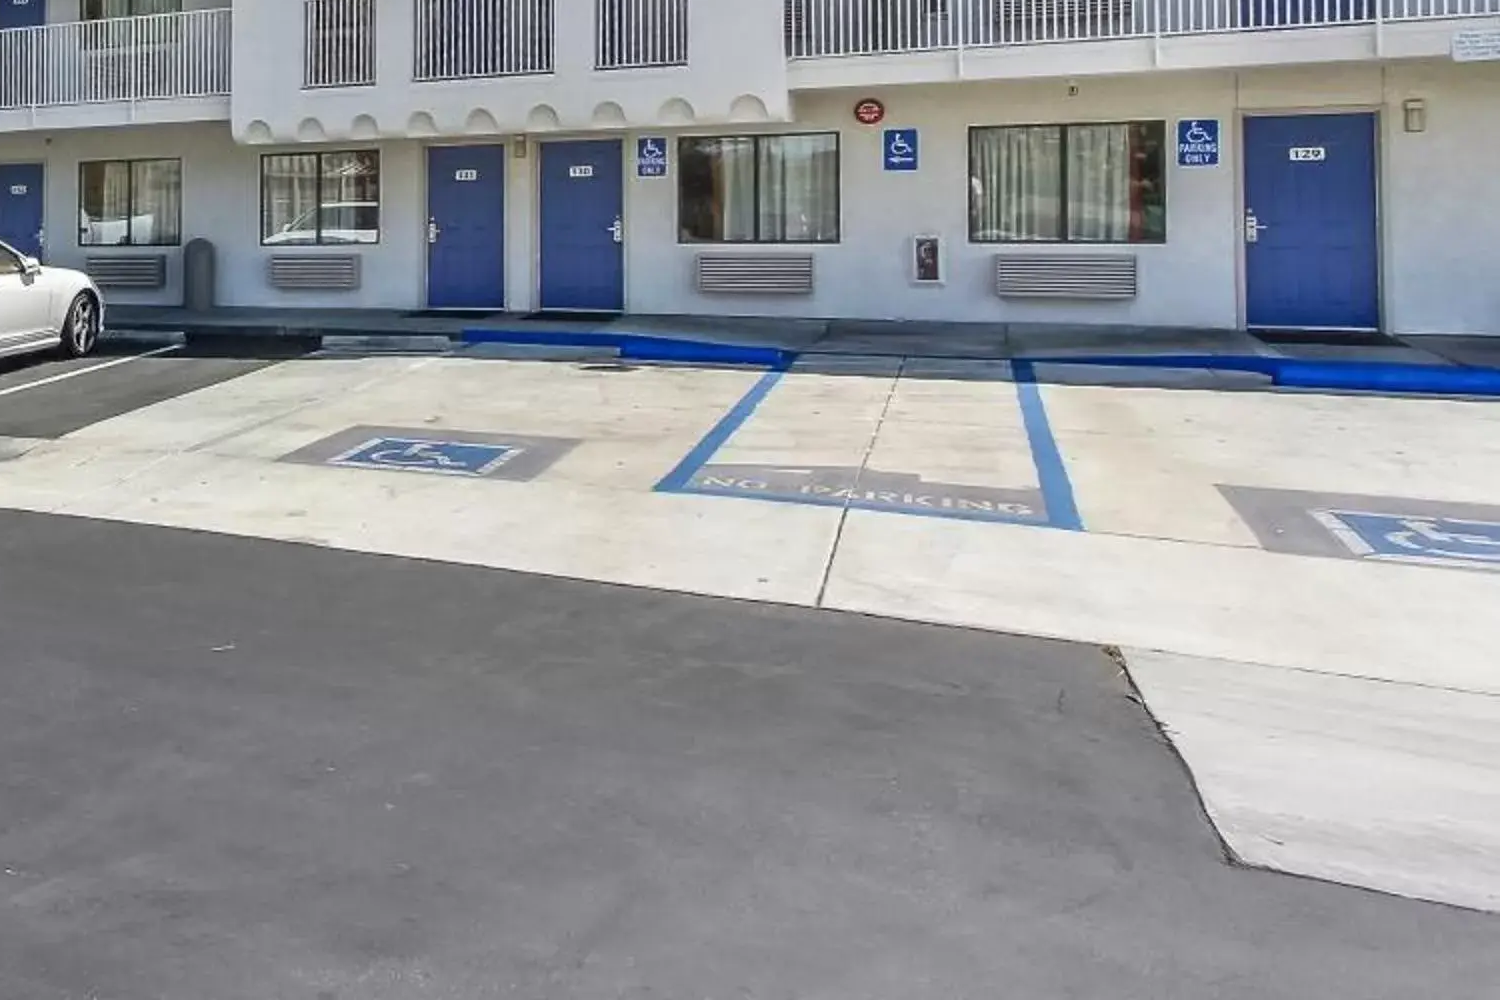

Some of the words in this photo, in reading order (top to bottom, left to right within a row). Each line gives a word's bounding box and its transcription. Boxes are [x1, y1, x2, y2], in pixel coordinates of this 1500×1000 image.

[1180, 143, 1217, 152] PARKING
[1185, 154, 1210, 162] ONLY
[1292, 149, 1321, 159] 129
[702, 476, 768, 489] NO
[801, 484, 1034, 515] PARKING
